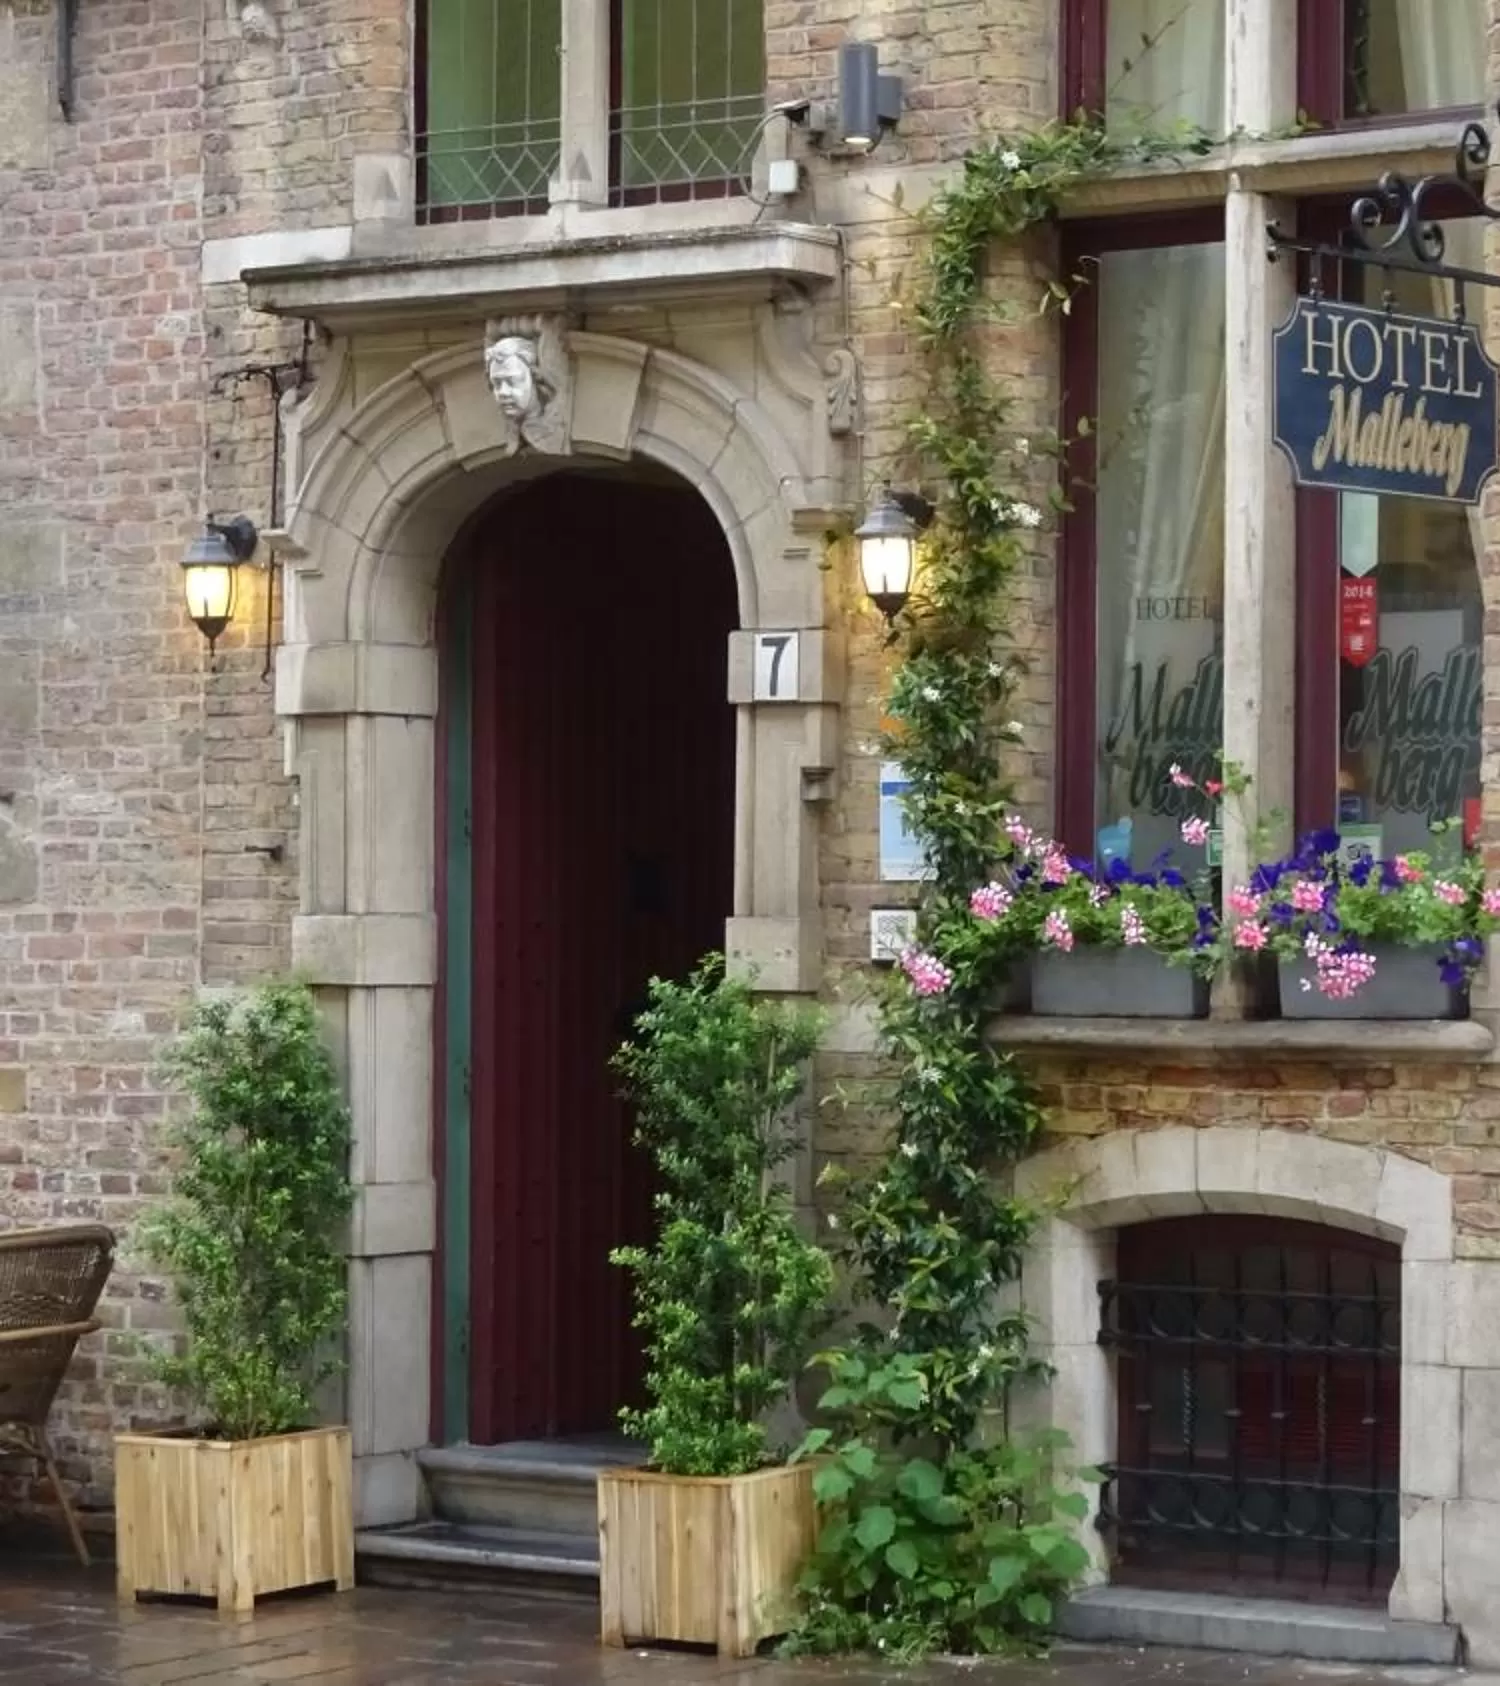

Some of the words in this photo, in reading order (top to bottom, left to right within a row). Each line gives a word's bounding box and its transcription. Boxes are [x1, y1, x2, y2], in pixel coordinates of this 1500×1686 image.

[1301, 310, 1484, 398] HOTEL
[1312, 384, 1470, 497] Malleberg
[1136, 596, 1215, 621] HOTEL
[761, 636, 792, 697] 7
[1105, 652, 1224, 752] Mall
